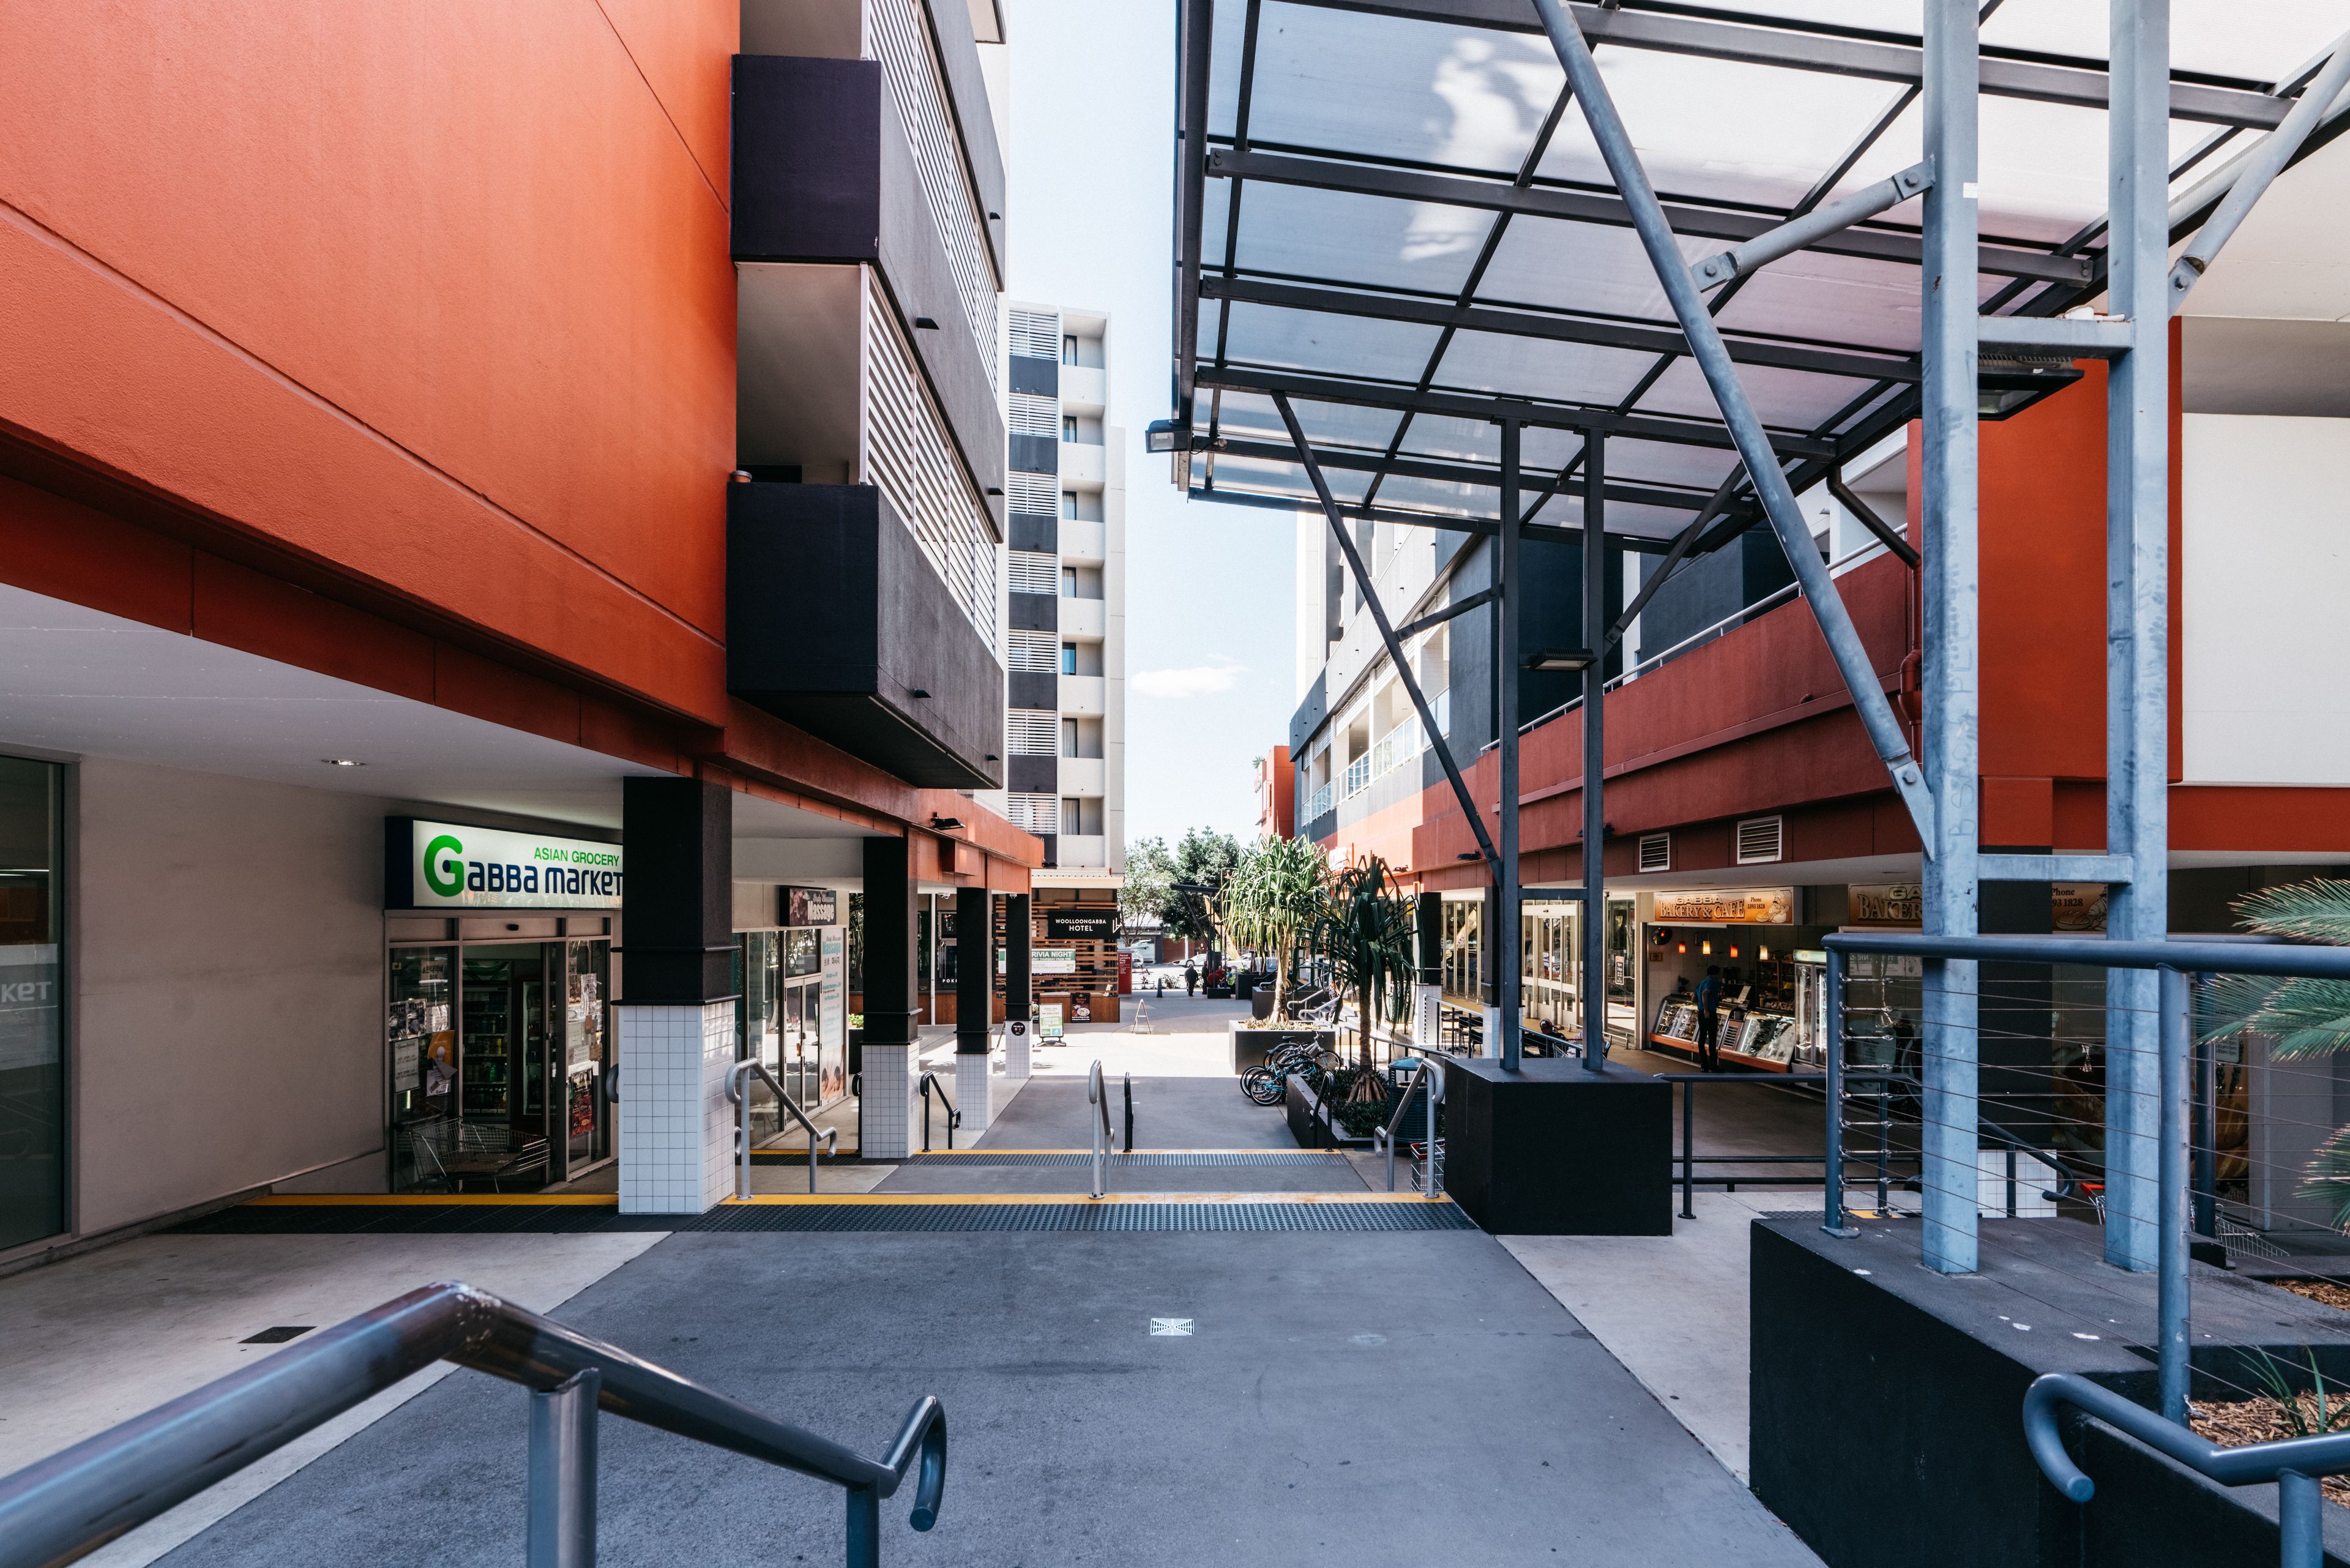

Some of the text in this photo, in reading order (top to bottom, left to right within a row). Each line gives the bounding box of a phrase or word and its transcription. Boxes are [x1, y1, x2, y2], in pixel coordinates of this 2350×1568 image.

[534, 847, 619, 867] ASIAN GROCERY
[1660, 898, 1745, 918] BAKERY & CAFE
[1676, 895, 1723, 905] GABBA
[1857, 894, 1922, 921] BAKER
[2064, 898, 2083, 906] 1828
[808, 900, 834, 922] Massage
